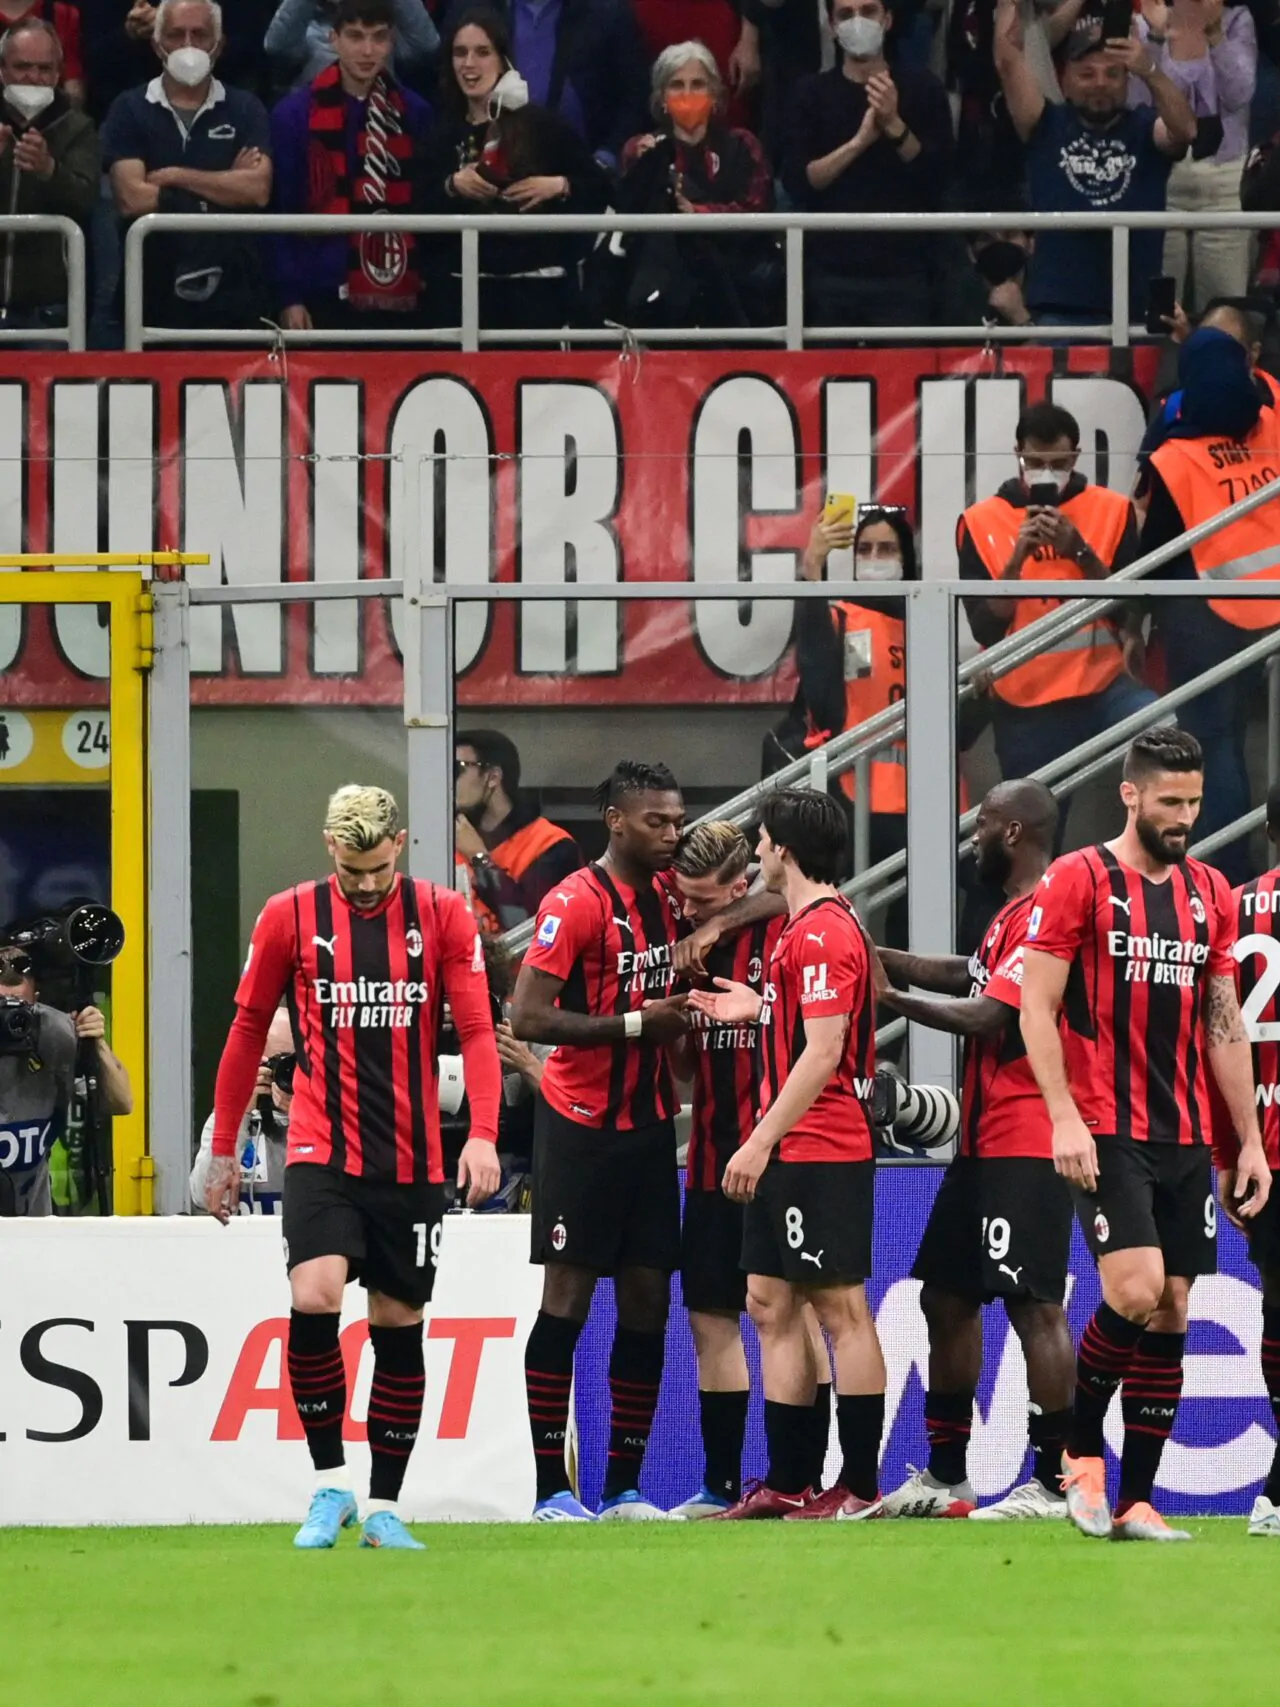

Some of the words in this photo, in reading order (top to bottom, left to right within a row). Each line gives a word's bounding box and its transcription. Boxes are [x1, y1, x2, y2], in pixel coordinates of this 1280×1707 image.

[0, 374, 624, 679] UNIOR
[77, 720, 109, 754] 24
[616, 939, 677, 975] Emir
[1124, 960, 1151, 982] FLY
[1153, 961, 1195, 987] BETTER
[312, 975, 428, 1004] Emirates
[331, 1005, 357, 1028] FLY
[360, 1005, 413, 1028] BETTER
[412, 1221, 443, 1268] 19
[785, 1206, 804, 1249] 8
[0, 1315, 517, 1443] SPAT
[1140, 1406, 1175, 1417] ACM
[384, 1430, 417, 1440] ACM
